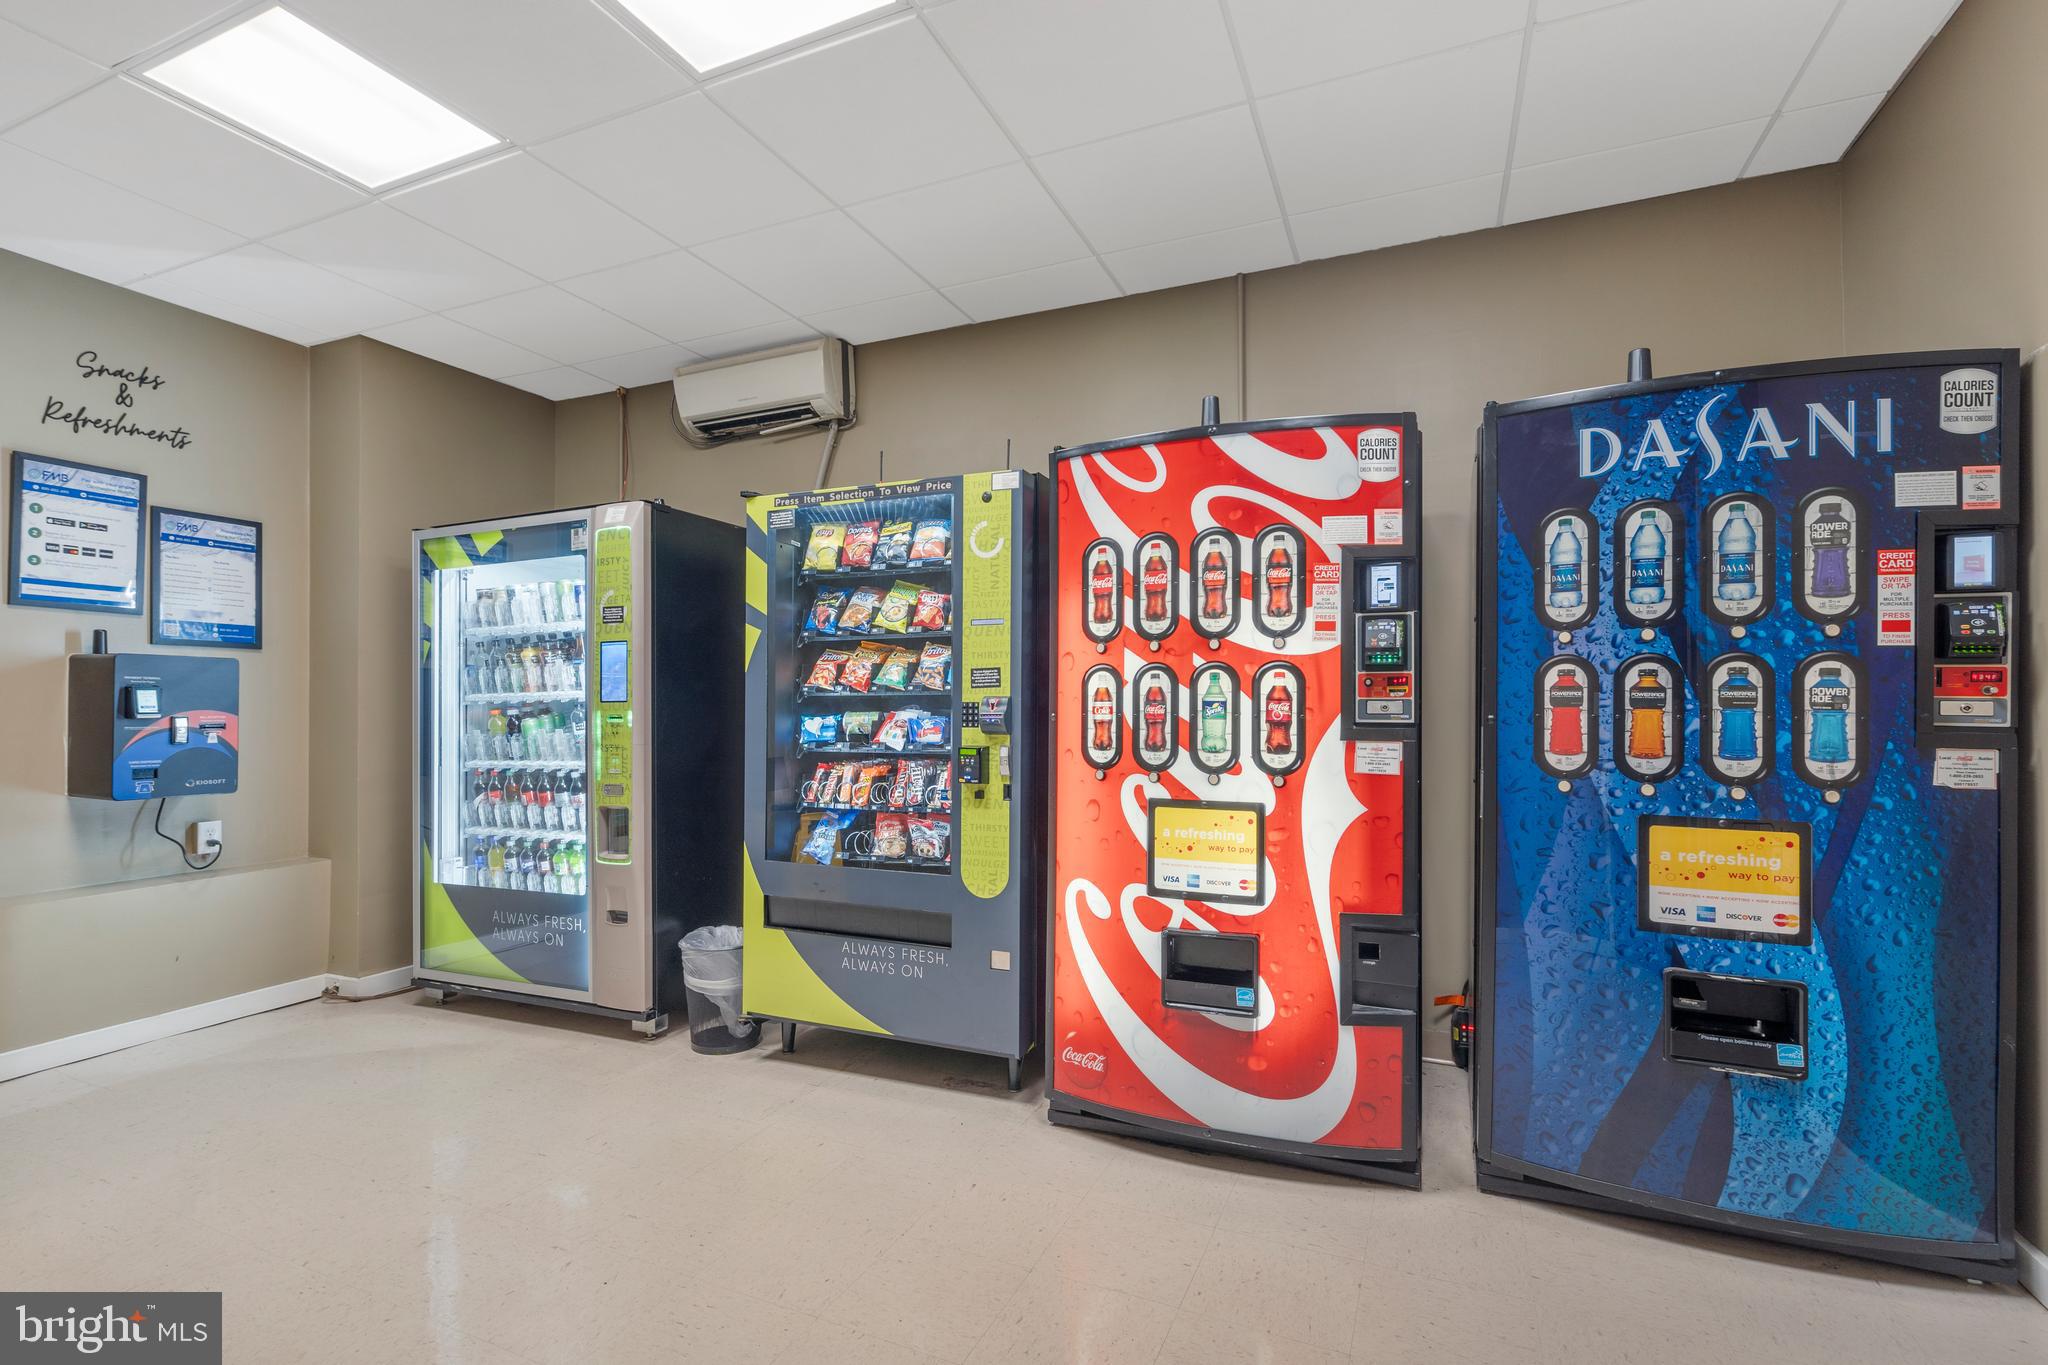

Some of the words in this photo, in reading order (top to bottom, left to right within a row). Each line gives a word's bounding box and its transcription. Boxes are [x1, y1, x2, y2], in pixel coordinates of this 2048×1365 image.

[76, 351, 165, 390] Snacks
[1944, 380, 1994, 391] CALORIES
[115, 382, 134, 408] &
[1944, 392, 1994, 408] COUNT
[41, 395, 193, 450] Refreshments
[1360, 438, 1397, 447] CALORIES
[1579, 392, 1892, 481] DASANI
[1360, 448, 1397, 460] COUNT
[42, 470, 69, 482] FMB
[775, 497, 799, 506] Press
[803, 495, 825, 504] Item
[829, 488, 875, 501] Selection
[879, 487, 891, 496] To
[896, 484, 921, 494] View
[926, 481, 952, 491] Price
[176, 522, 199, 532] FMB
[1811, 522, 1848, 531] POWER
[1811, 530, 1832, 539] ADE
[1721, 564, 1754, 573] DASANI
[1879, 560, 1914, 568] CARD
[1552, 574, 1580, 582] DASANI
[1632, 569, 1663, 578] DASANI
[1811, 687, 1848, 696] POWER
[1811, 695, 1832, 703] ADE
[1205, 705, 1225, 718] Sprite
[1163, 829, 1170, 837] a
[1174, 828, 1245, 844] refreshing
[1208, 845, 1225, 853] way
[1660, 851, 1671, 860] a
[1678, 850, 1782, 871] refreshing
[1163, 875, 1180, 883] VISA
[1728, 871, 1752, 881] way
[1756, 872, 1769, 881] to
[1774, 875, 1795, 884] pay
[1660, 906, 1686, 916] VISA
[1726, 913, 1762, 921] DISCOVER
[492, 910, 539, 927] ALWAYS
[544, 915, 586, 934] FRESH,
[492, 927, 539, 944] ALWAYS
[544, 933, 564, 947] ON
[841, 941, 895, 959] ALWAYS
[901, 948, 949, 967] FRESH,
[841, 957, 895, 975] ALWAYS
[901, 964, 923, 979] ON
[1062, 1046, 1107, 1072] Coca-Cola
